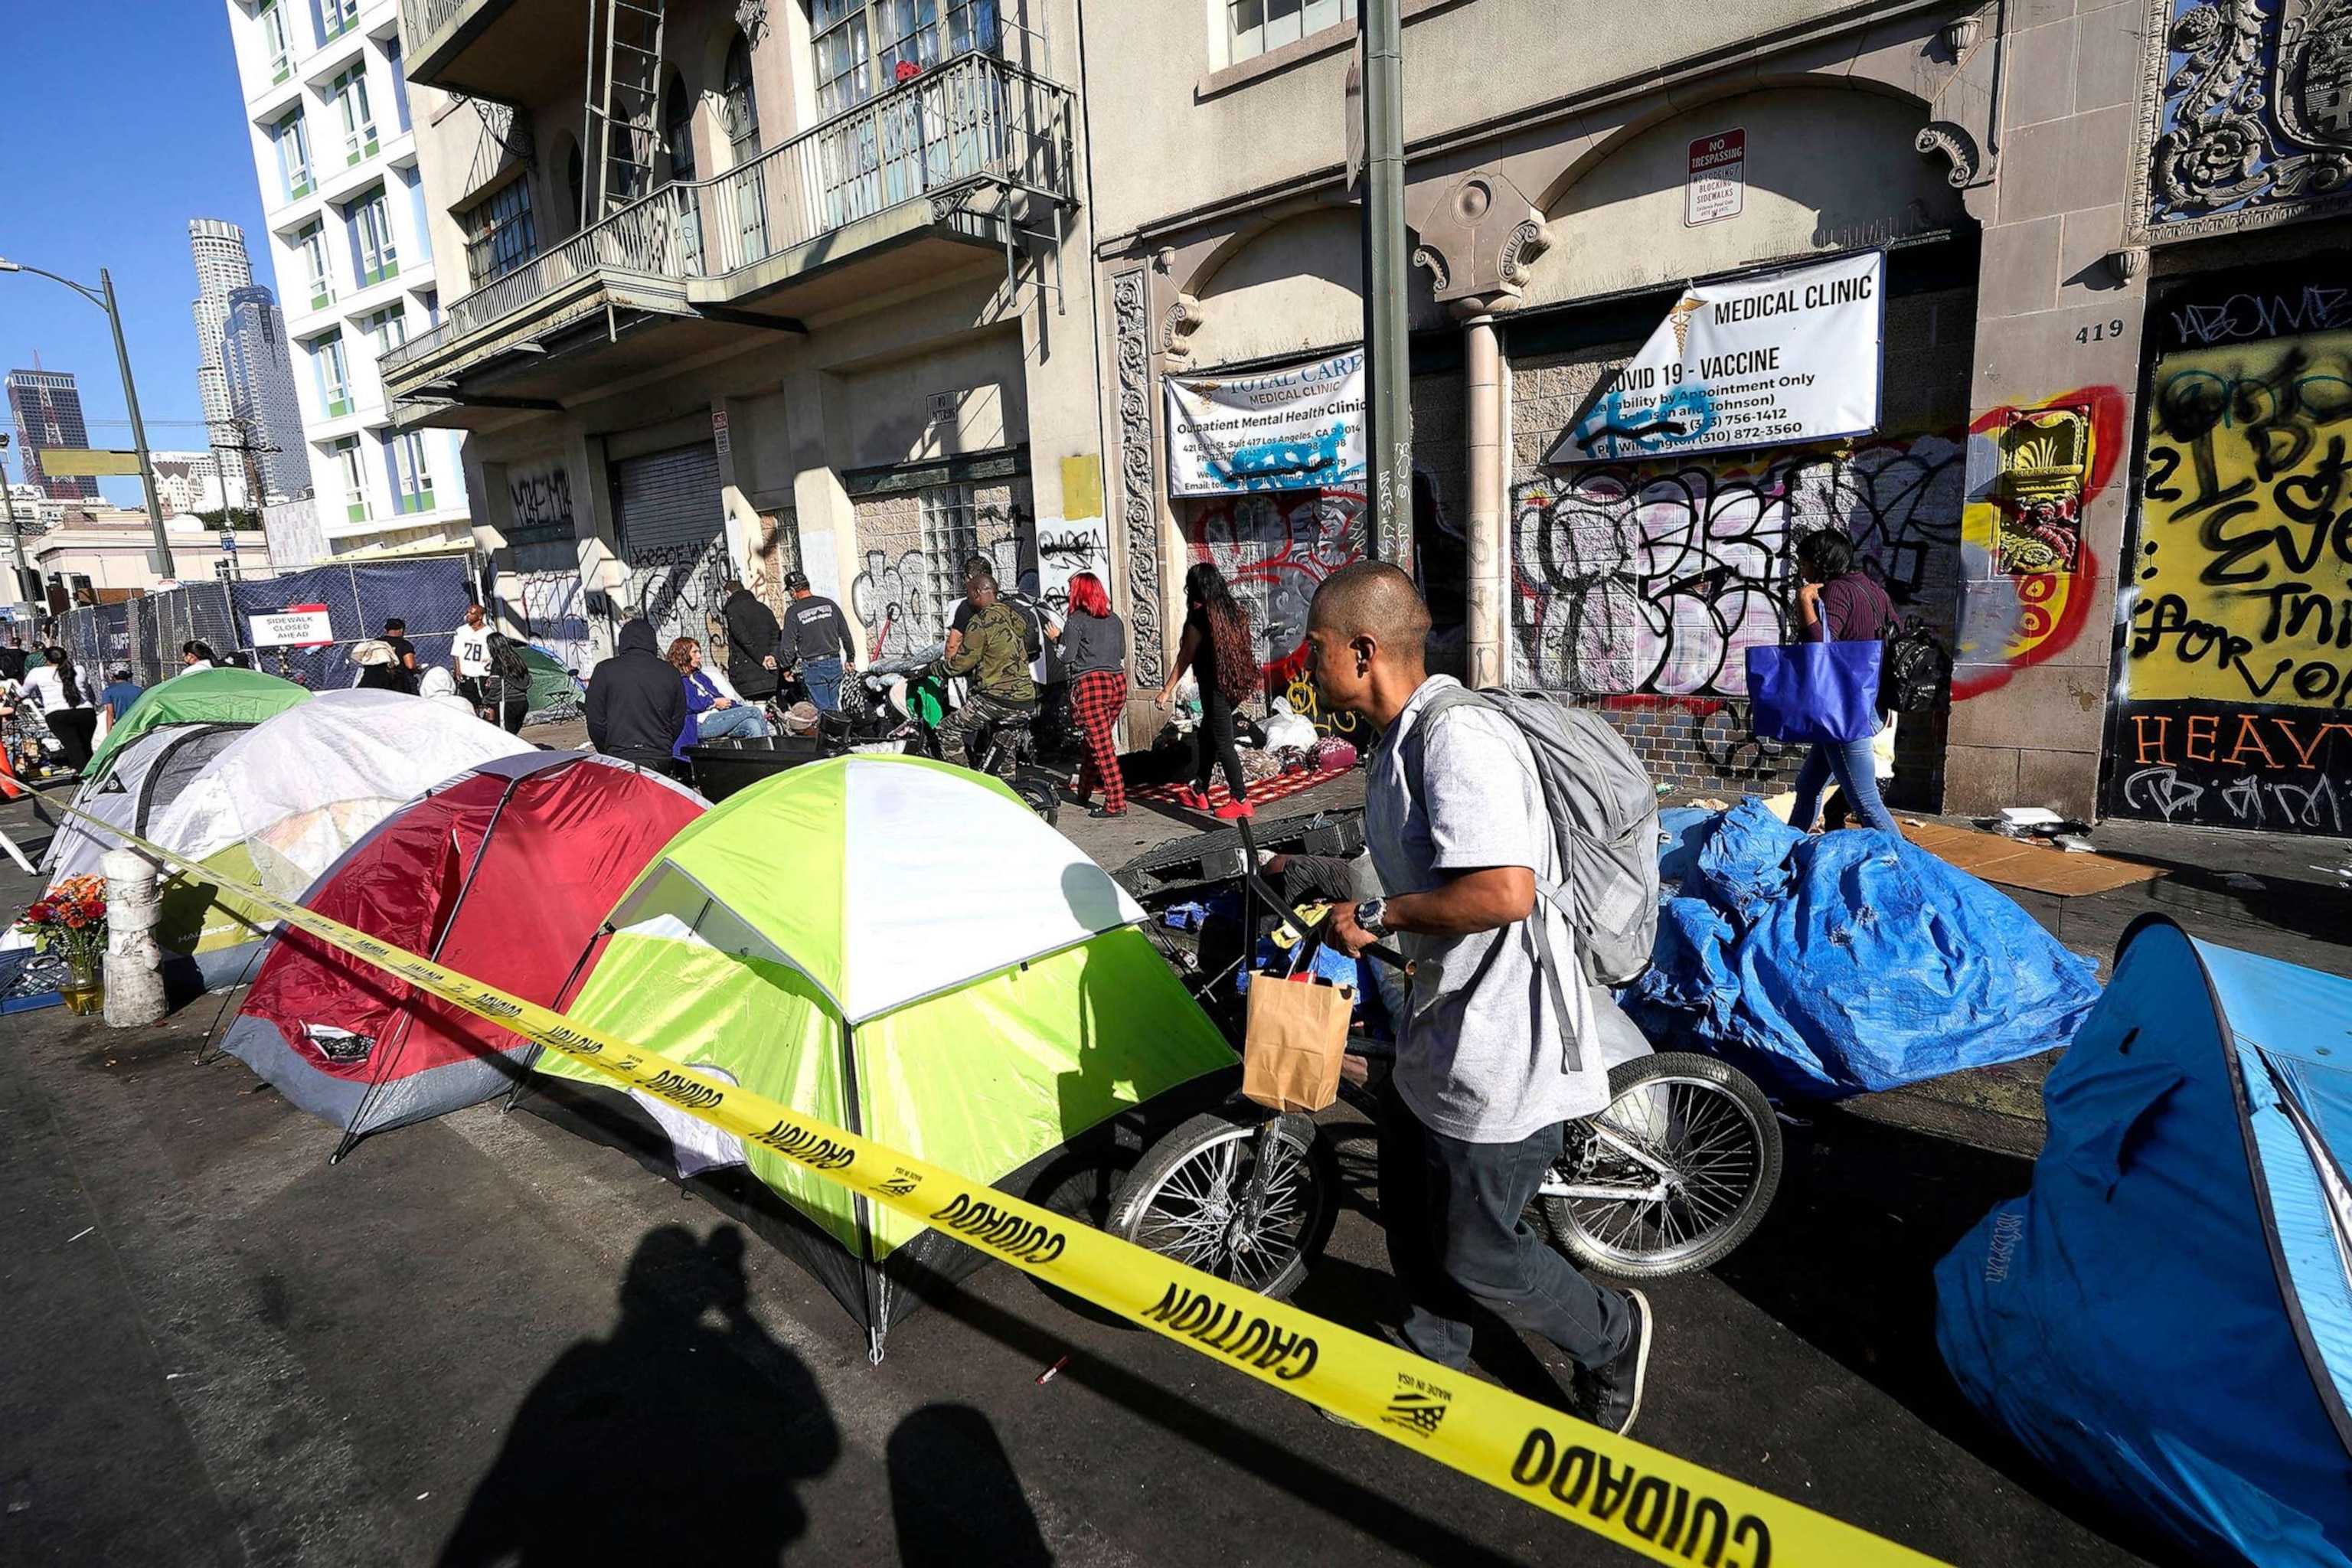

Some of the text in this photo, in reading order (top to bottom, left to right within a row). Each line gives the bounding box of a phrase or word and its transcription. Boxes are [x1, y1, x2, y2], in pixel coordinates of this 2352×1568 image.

[1692, 146, 1743, 168] TRESPASSING
[1709, 139, 1725, 152] NO
[1697, 188, 1733, 204] SIDEWALKS
[1699, 179, 1732, 193] BLOCKING
[1715, 275, 1872, 325] MEDICAL CLINIC
[2076, 318, 2124, 345] 419
[1302, 353, 1363, 382] CARE
[1662, 363, 1683, 385] 19
[1700, 347, 1779, 380] VACCINE
[1250, 381, 1340, 406] MEDICAL CLINIC
[1660, 394, 1676, 405] by
[1678, 380, 1775, 402] Appointment
[1779, 372, 1816, 391] Only
[1708, 394, 1775, 412] Johnson)
[1242, 412, 1283, 429] Mental
[1286, 407, 1325, 424] Health
[1725, 407, 1787, 424] 756-1412
[1183, 444, 1197, 452] 421
[1263, 436, 1278, 445] Los
[1279, 431, 1314, 444] Angeles,
[1315, 429, 1329, 437] CA
[1699, 430, 1730, 445] (310)
[1734, 422, 1802, 439] 872-3560
[1185, 481, 1210, 491] Email:
[266, 616, 313, 625] SIDEWALK
[464, 642, 482, 662] 28
[635, 1069, 724, 1109] CUIDADO
[758, 1120, 857, 1170] CAUTION
[929, 1193, 1067, 1264] CUIDADO
[1142, 1282, 1319, 1380] CAUTION
[1398, 1372, 1452, 1402] MADE IN USA
[1511, 1426, 1772, 1568] CUIDADO
